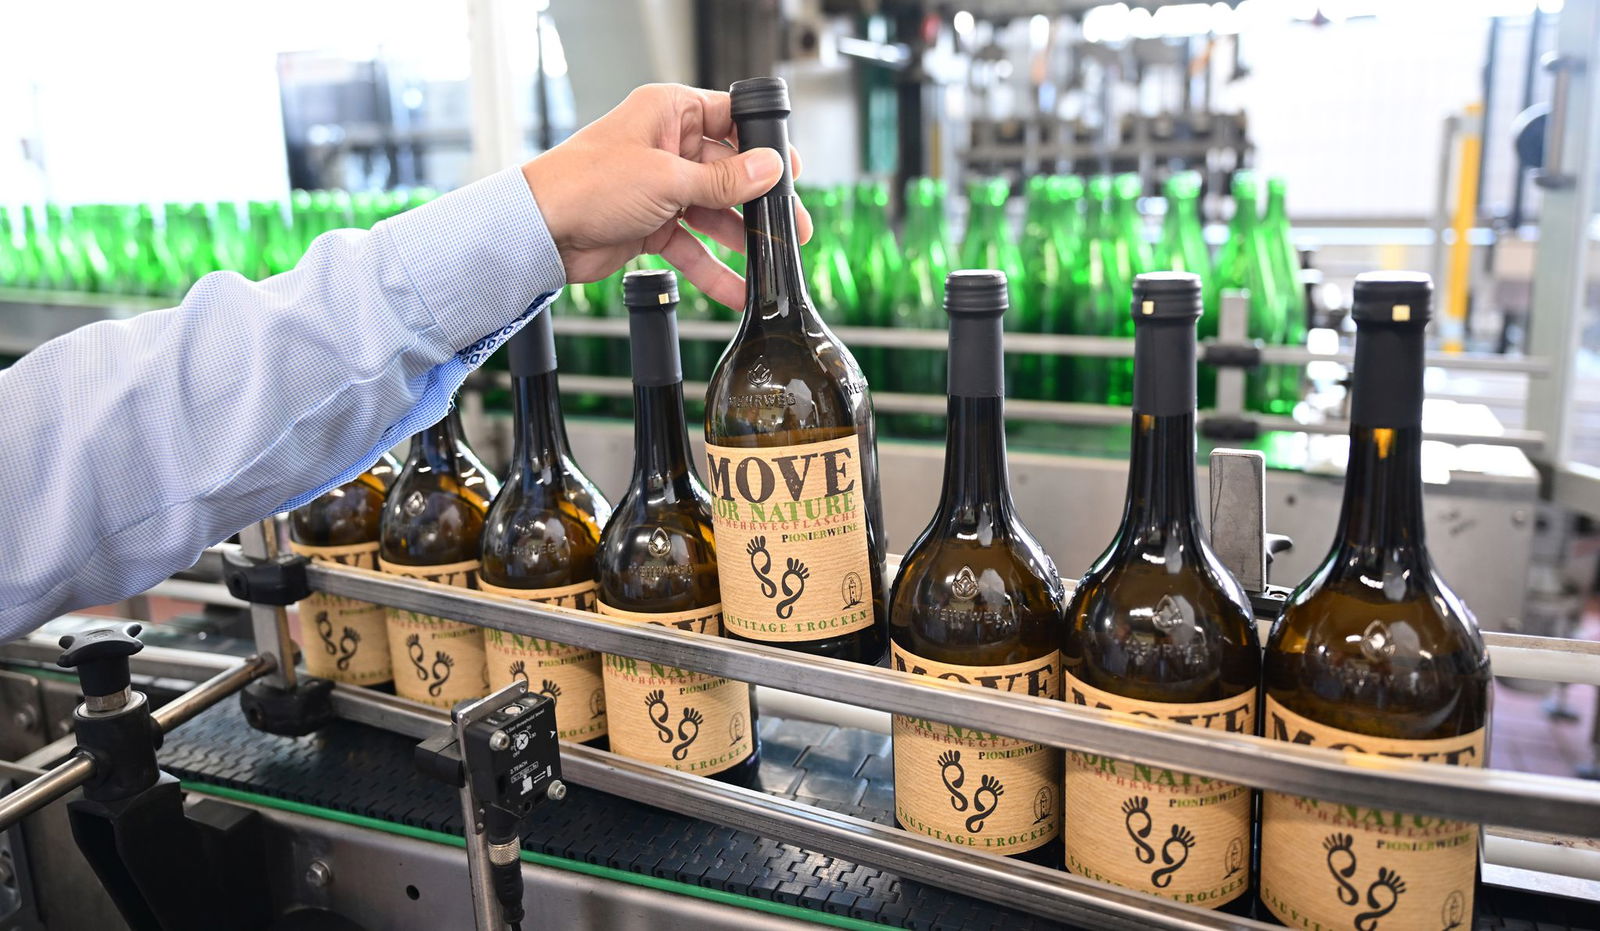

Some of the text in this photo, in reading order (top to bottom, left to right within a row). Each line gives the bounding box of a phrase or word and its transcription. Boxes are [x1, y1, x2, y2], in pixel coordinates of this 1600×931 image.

[706, 447, 855, 503] MOVE
[725, 510, 857, 531] MEHRWEGFLASCHE
[748, 491, 857, 523] NATURE
[781, 522, 859, 543] PIONIERWEINE
[795, 609, 867, 633] TROCKEN
[898, 806, 1055, 848] SAUVITAGE TROCKEN
